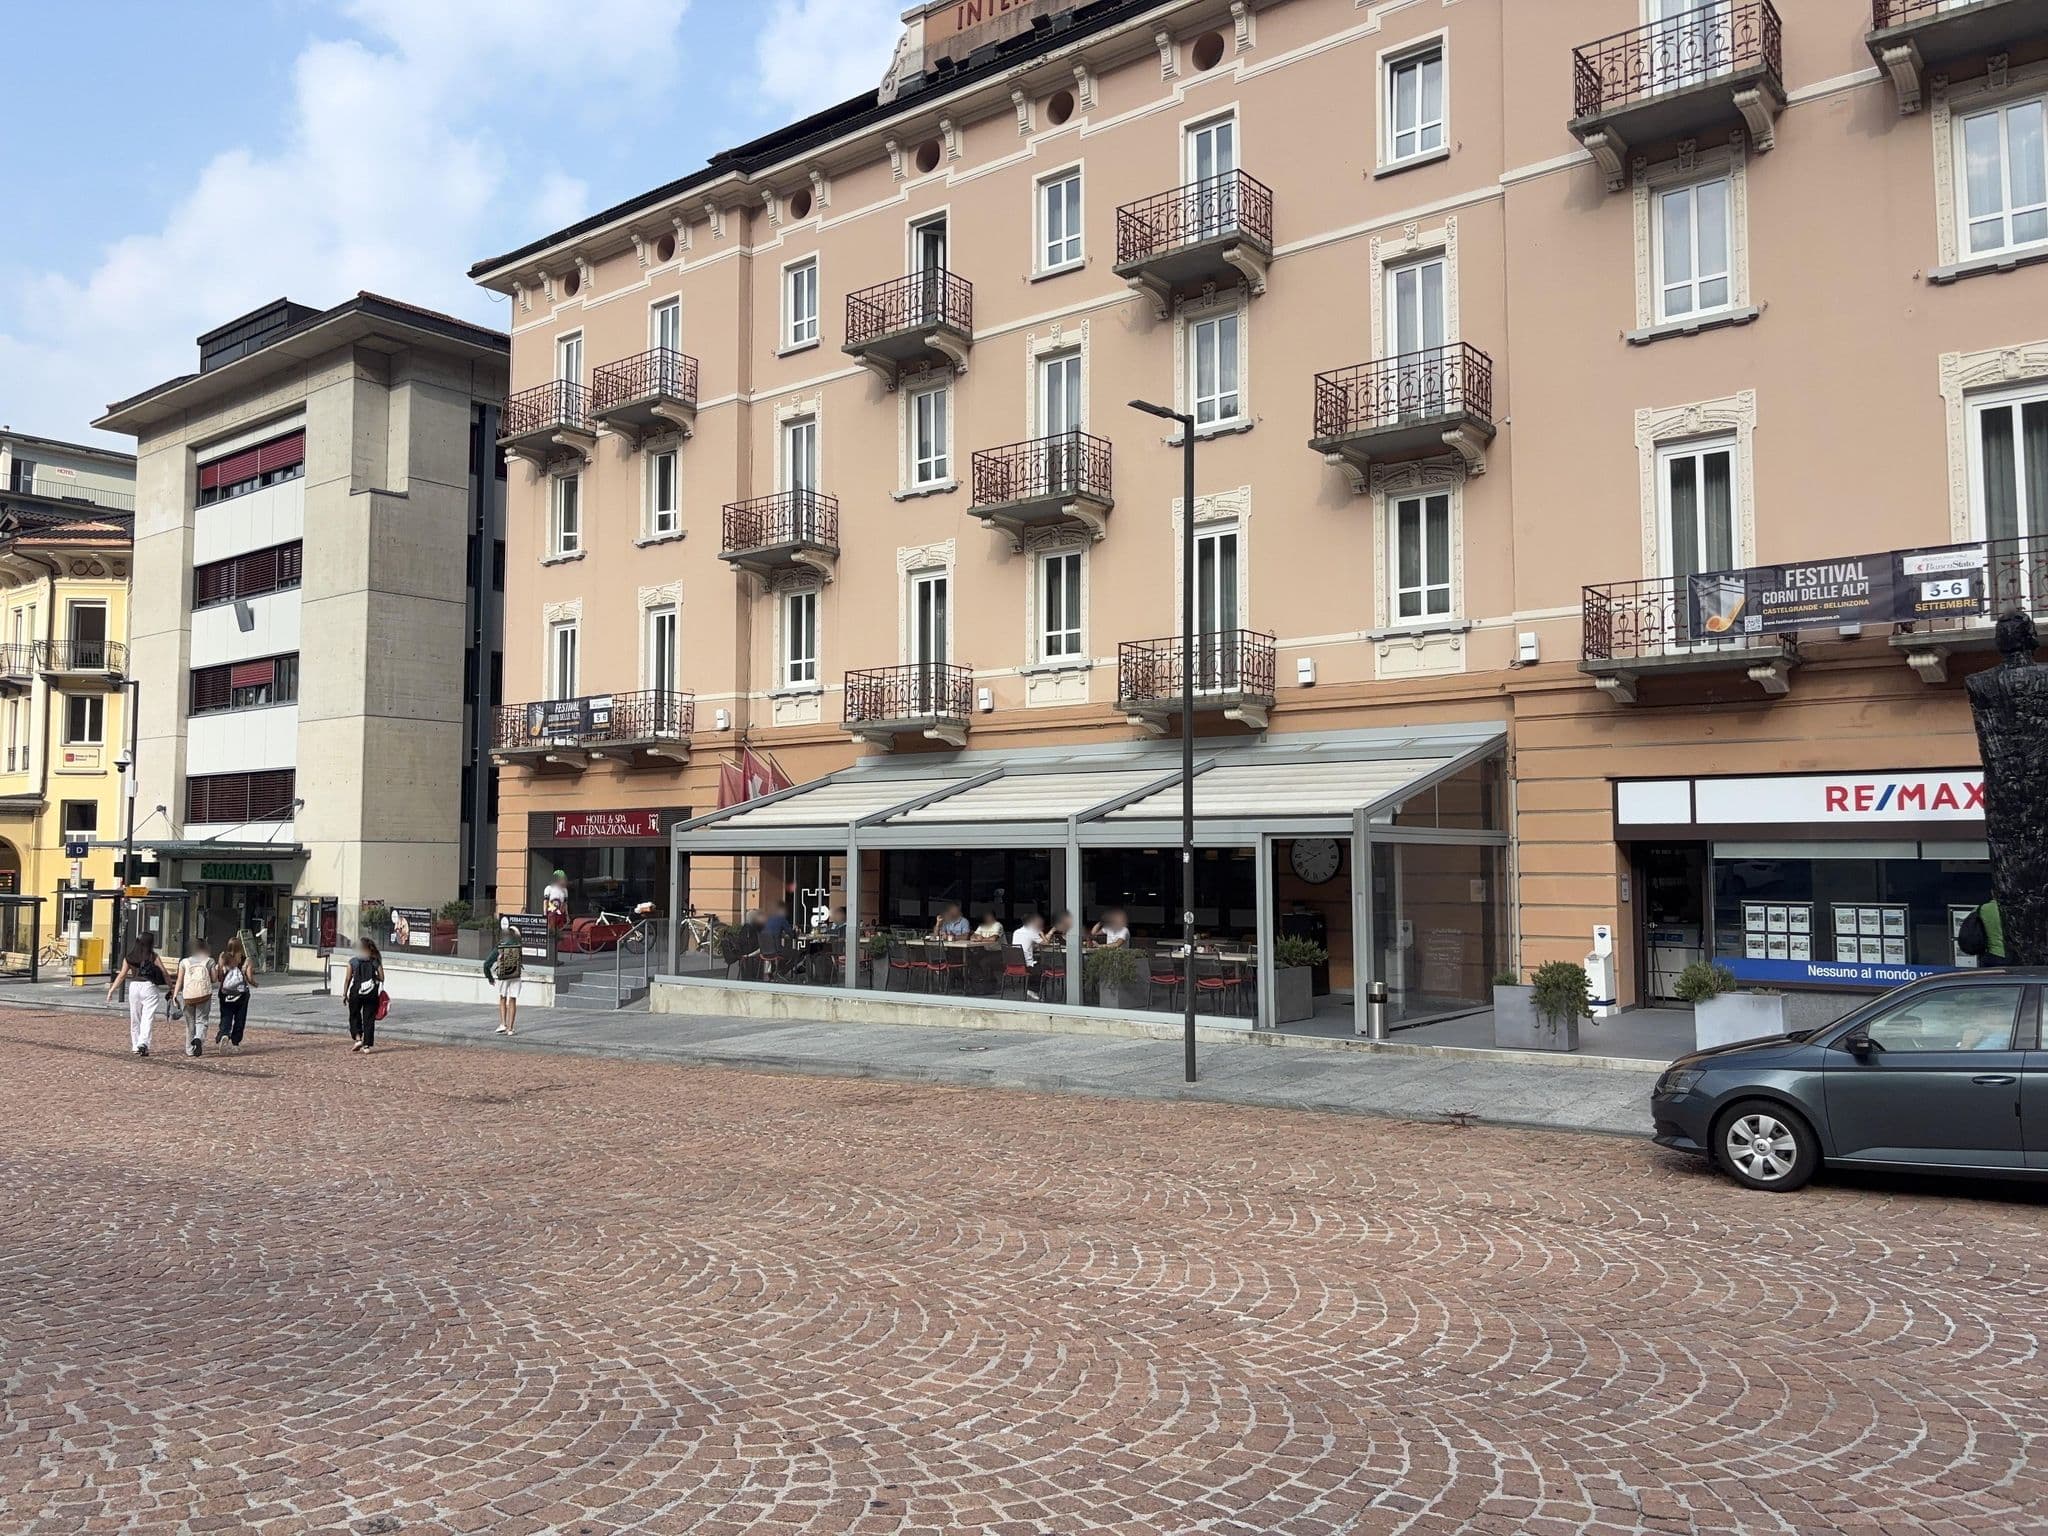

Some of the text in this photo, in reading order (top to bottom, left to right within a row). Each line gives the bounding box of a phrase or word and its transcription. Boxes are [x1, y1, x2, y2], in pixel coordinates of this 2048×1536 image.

[1785, 562, 1869, 588] FESTIVAL
[1762, 582, 1870, 605] CORNI DELLE ALPI
[1762, 604, 1818, 615] CASTELGRANDE
[1823, 599, 1870, 609] BELLINZONA
[1914, 598, 1979, 612] SETTEMBRE
[555, 701, 580, 713] FESTIVAL
[1825, 782, 1985, 812] RE/MAX
[585, 814, 627, 824] HOTEL & SPA
[570, 823, 642, 836] INTERNAZIONALE
[201, 863, 271, 881] FARMACIA
[1807, 964, 1858, 978] Nessuno
[1860, 967, 1872, 979] al
[1875, 969, 1917, 981] mondo
